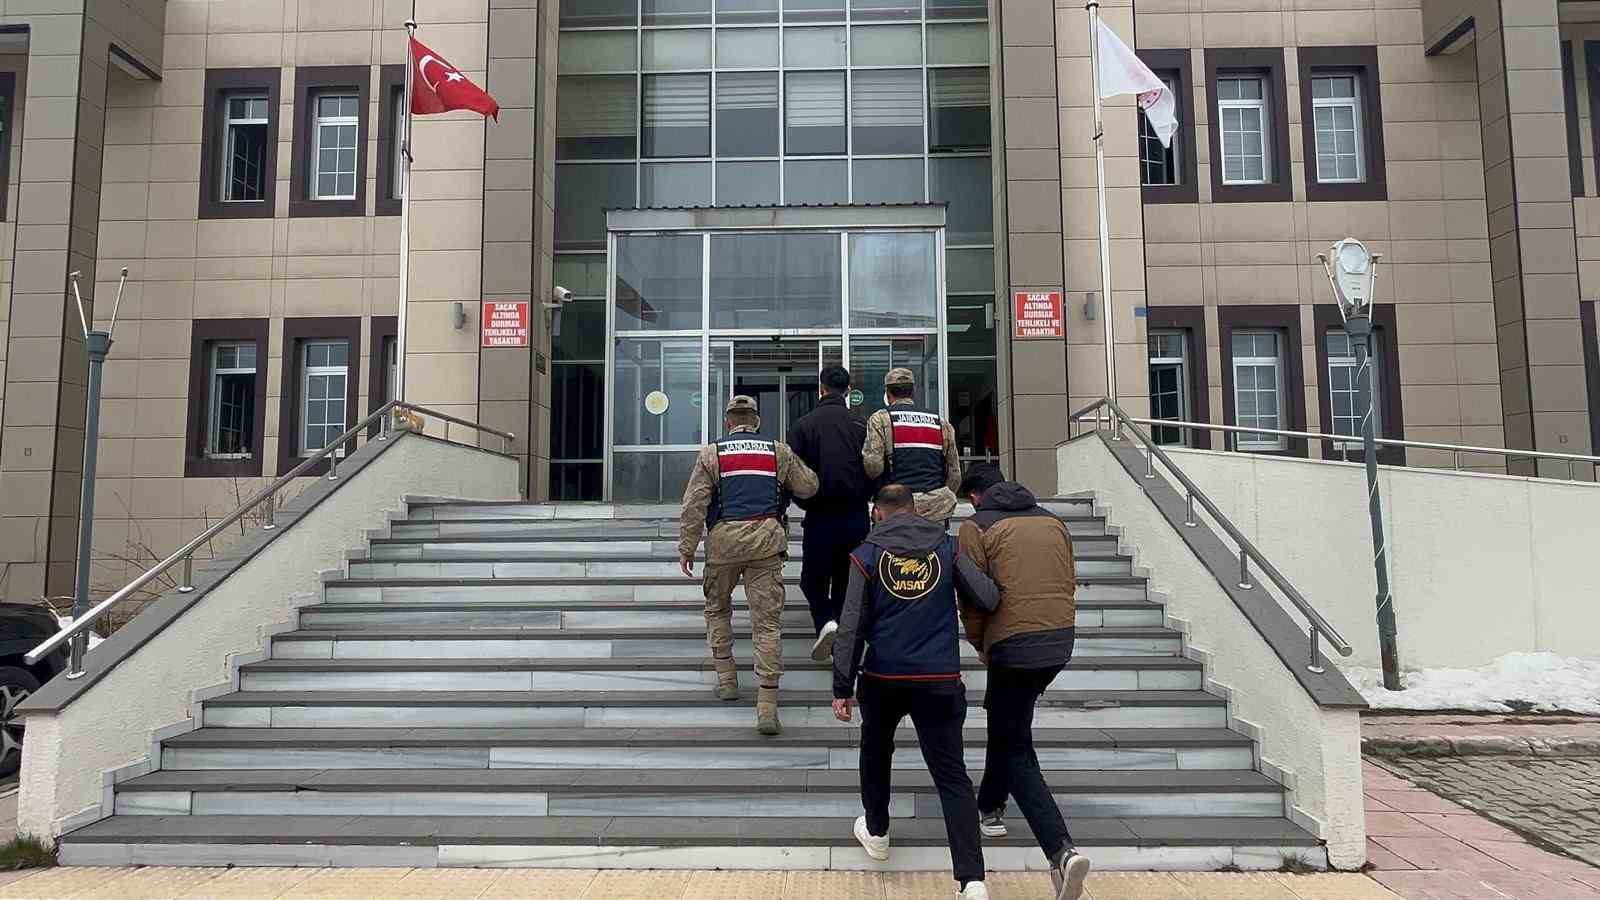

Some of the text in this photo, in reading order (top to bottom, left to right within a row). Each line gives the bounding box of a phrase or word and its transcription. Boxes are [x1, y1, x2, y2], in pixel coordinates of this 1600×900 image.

[897, 413, 936, 425] JANDARMA
[725, 442, 770, 452] JANDARMA
[893, 580, 926, 591] JASAT
